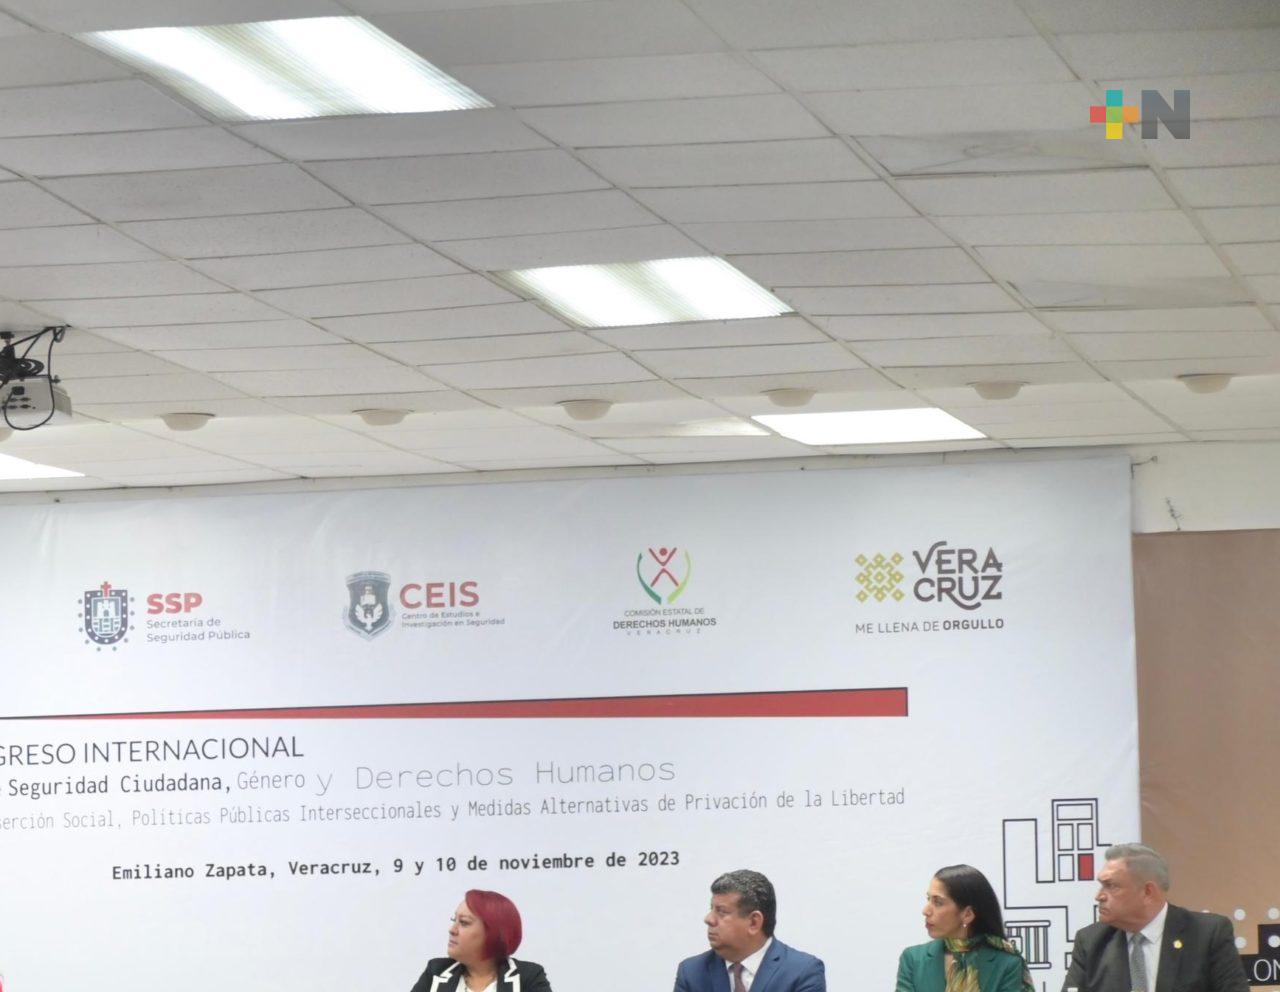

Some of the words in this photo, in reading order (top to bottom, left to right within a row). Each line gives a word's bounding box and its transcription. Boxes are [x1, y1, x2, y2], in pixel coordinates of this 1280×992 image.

[913, 540, 1003, 575] VERA
[147, 592, 203, 615] SSP
[399, 581, 480, 609] CEIS
[913, 575, 1003, 611] CRUZ
[206, 617, 221, 627] de
[466, 618, 505, 627] Seguridad
[613, 620, 666, 630] DERECHOS
[668, 618, 717, 628] HUMANOS
[662, 608, 692, 616] ESTATAL
[694, 607, 705, 615] DE
[146, 632, 205, 643] Seguridad
[855, 623, 874, 634] ME
[878, 622, 919, 633] LLENA
[923, 621, 940, 632] DE
[943, 618, 1004, 631] ORGULLO
[84, 736, 305, 764] INTERNACIONAL
[8, 775, 109, 800] Seguridad
[120, 773, 231, 793] Ciudadana,
[237, 771, 306, 790] Género
[316, 773, 333, 796] y
[356, 762, 514, 790] Derechos
[536, 761, 677, 784] Humanos
[220, 806, 290, 823] Públicas
[300, 801, 442, 821] Interseccionales
[451, 804, 460, 821] y
[469, 798, 532, 817] Medidas
[540, 796, 649, 815] Alternativas
[657, 794, 677, 812] de
[685, 791, 768, 811] Privación
[776, 790, 795, 808] de
[805, 789, 823, 808] la
[831, 787, 906, 807] Libertad
[112, 864, 195, 881] Emiliano
[205, 863, 276, 881] Zapata,
[288, 860, 380, 877] Veracruz,
[393, 858, 404, 873] 9
[414, 862, 425, 876] y
[436, 857, 457, 872] 10
[467, 855, 488, 871] de
[499, 853, 595, 870] noviembre
[605, 852, 627, 868] de
[638, 851, 680, 867] 2023
